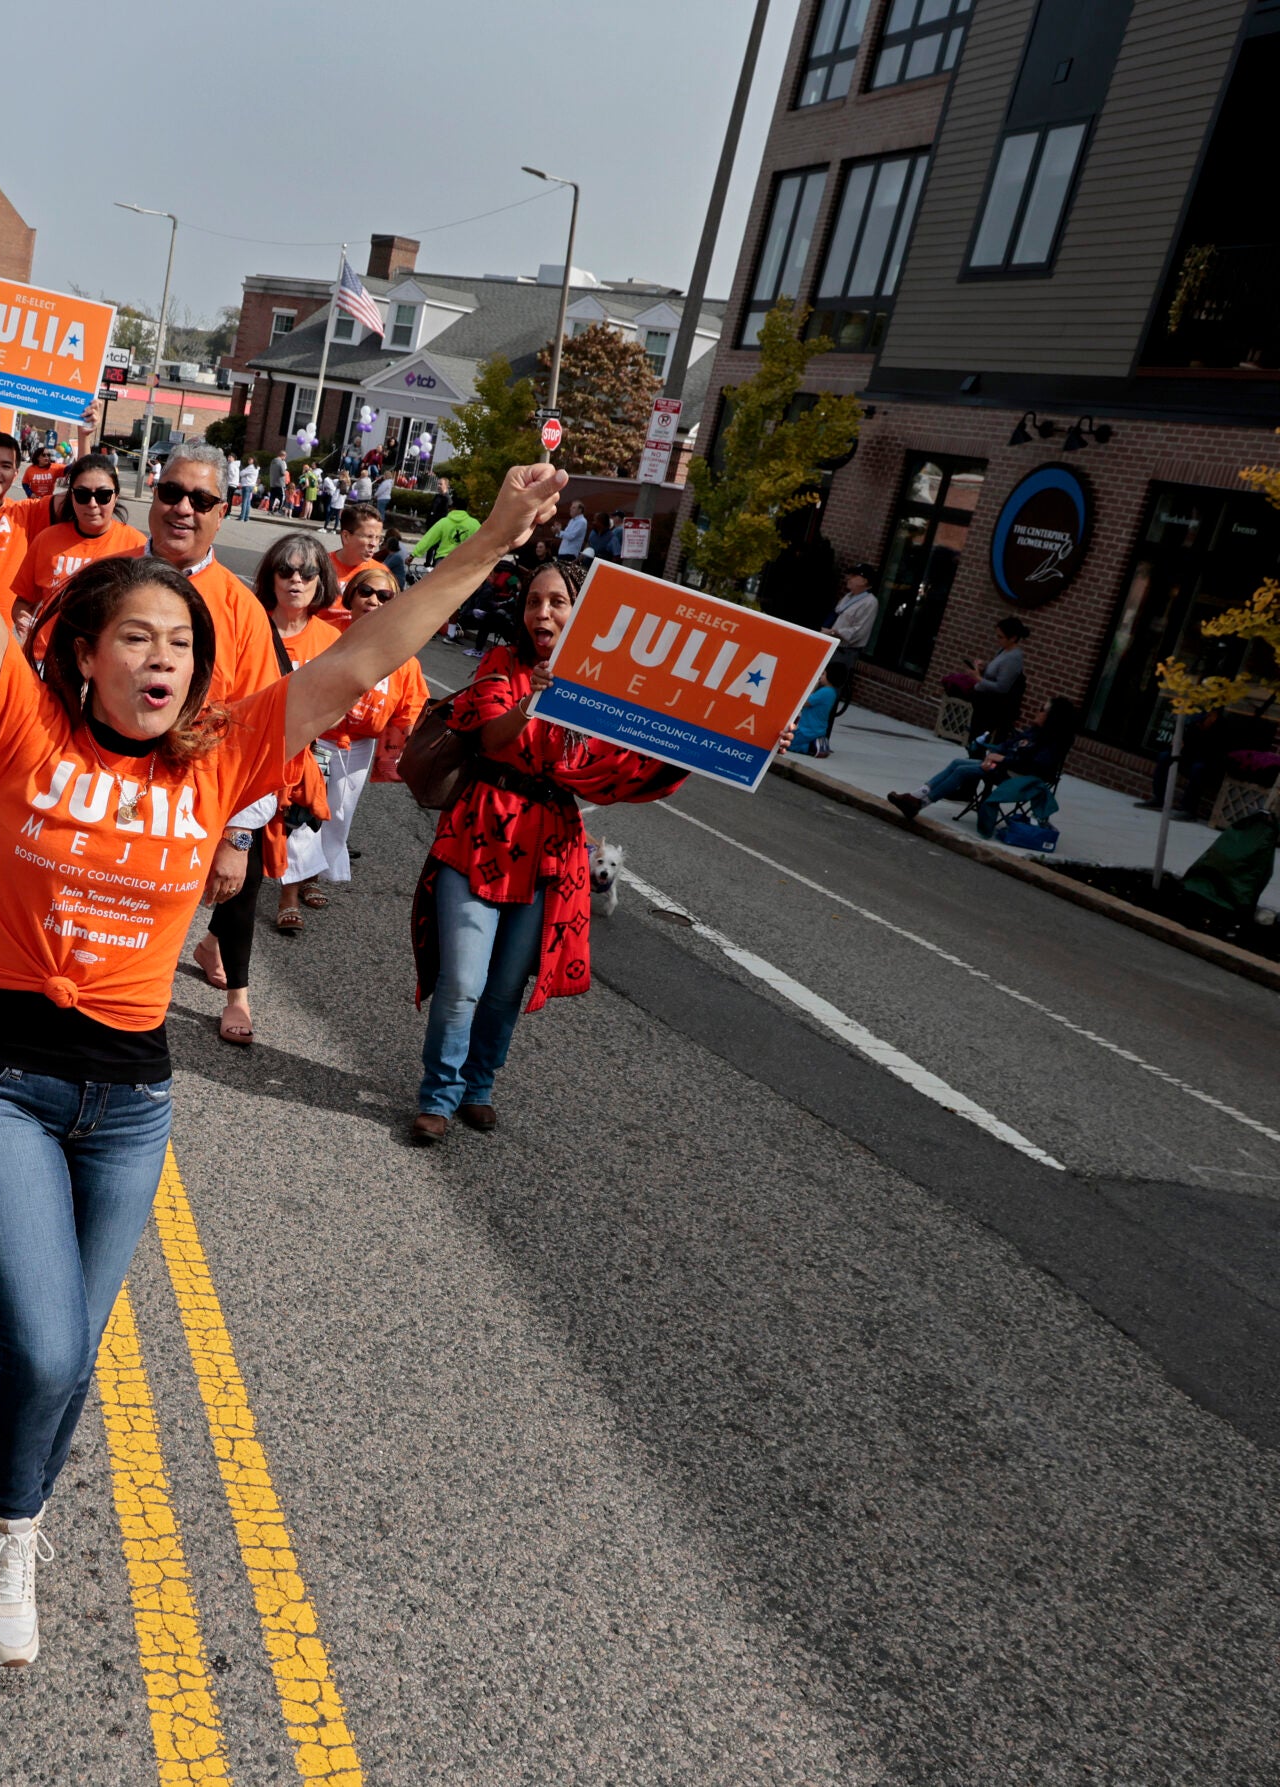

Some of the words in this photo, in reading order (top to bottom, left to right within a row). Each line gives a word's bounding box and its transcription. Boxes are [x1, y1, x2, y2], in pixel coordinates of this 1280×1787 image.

[15, 293, 56, 311] RE-ELECT
[110, 352, 128, 363] tcb
[0, 379, 15, 388] CITY
[16, 382, 49, 397] COUNCIL
[50, 391, 85, 405] AT-LARGE
[417, 374, 436, 389] tcb
[543, 428, 560, 441] STOP
[1013, 525, 1027, 535] THE
[1026, 527, 1071, 542] CENTERPIECE
[1231, 522, 1258, 536] Events
[1016, 536, 1042, 548] FLOWER
[1042, 540, 1061, 551] SHOP
[675, 603, 740, 635] RE-ELECT
[591, 603, 778, 707] JULIA
[576, 656, 756, 736] MEJIA
[554, 687, 577, 702] FOR
[579, 696, 624, 718] BOSTON
[625, 712, 651, 727] CITY
[651, 721, 699, 745] COUNCIL
[700, 737, 754, 764] AT-LARGE
[31, 760, 208, 839] JULIA
[20, 814, 201, 870] MEJIA
[15, 845, 56, 871] BOSTON
[58, 863, 85, 877] CITY
[87, 870, 156, 891] COUNCILOR
[159, 882, 173, 893] AT
[175, 879, 200, 893] LARGE
[49, 898, 154, 926] juliaforboston.com
[59, 885, 83, 899] Join
[87, 889, 116, 904] Team
[118, 896, 151, 912] Mejia
[43, 913, 149, 949] #allmeansall
